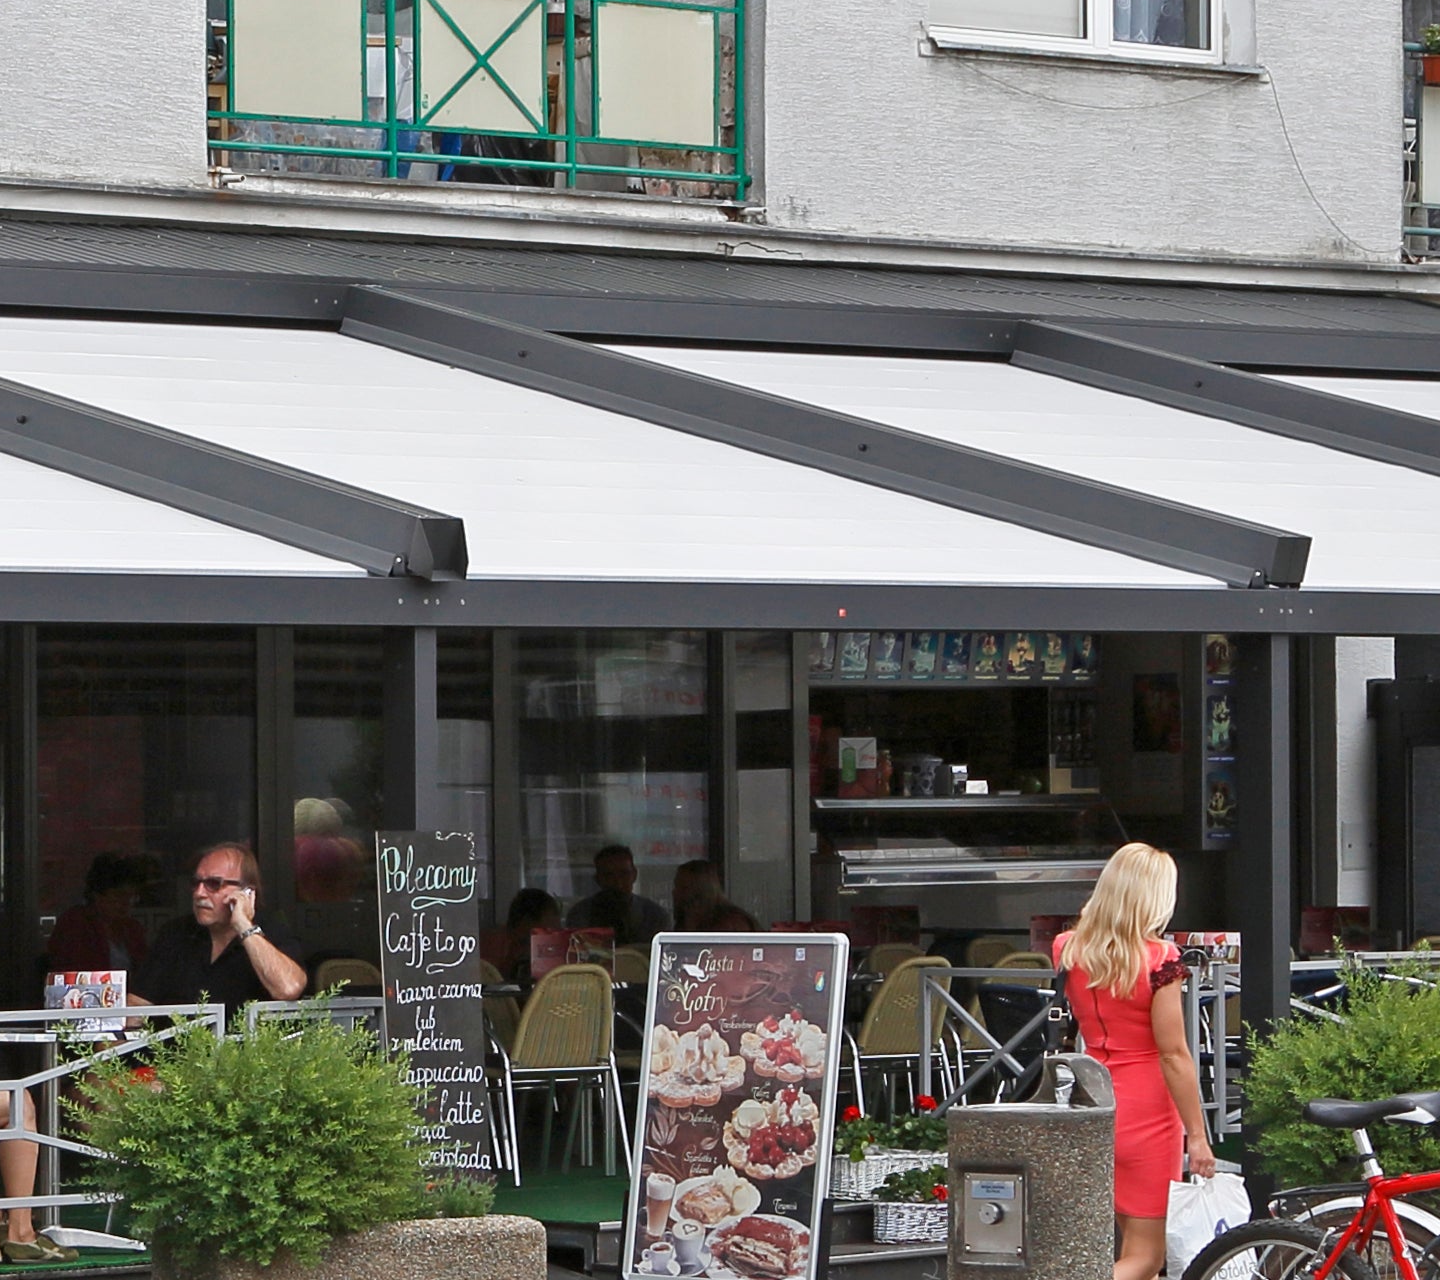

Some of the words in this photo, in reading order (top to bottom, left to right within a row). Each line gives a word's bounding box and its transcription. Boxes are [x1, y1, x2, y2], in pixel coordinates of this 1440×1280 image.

[381, 845, 476, 909] Polecamy
[386, 912, 431, 968] Caffe
[434, 916, 454, 953] to
[416, 1005, 436, 1031] lub
[404, 1030, 464, 1051] mlekiem
